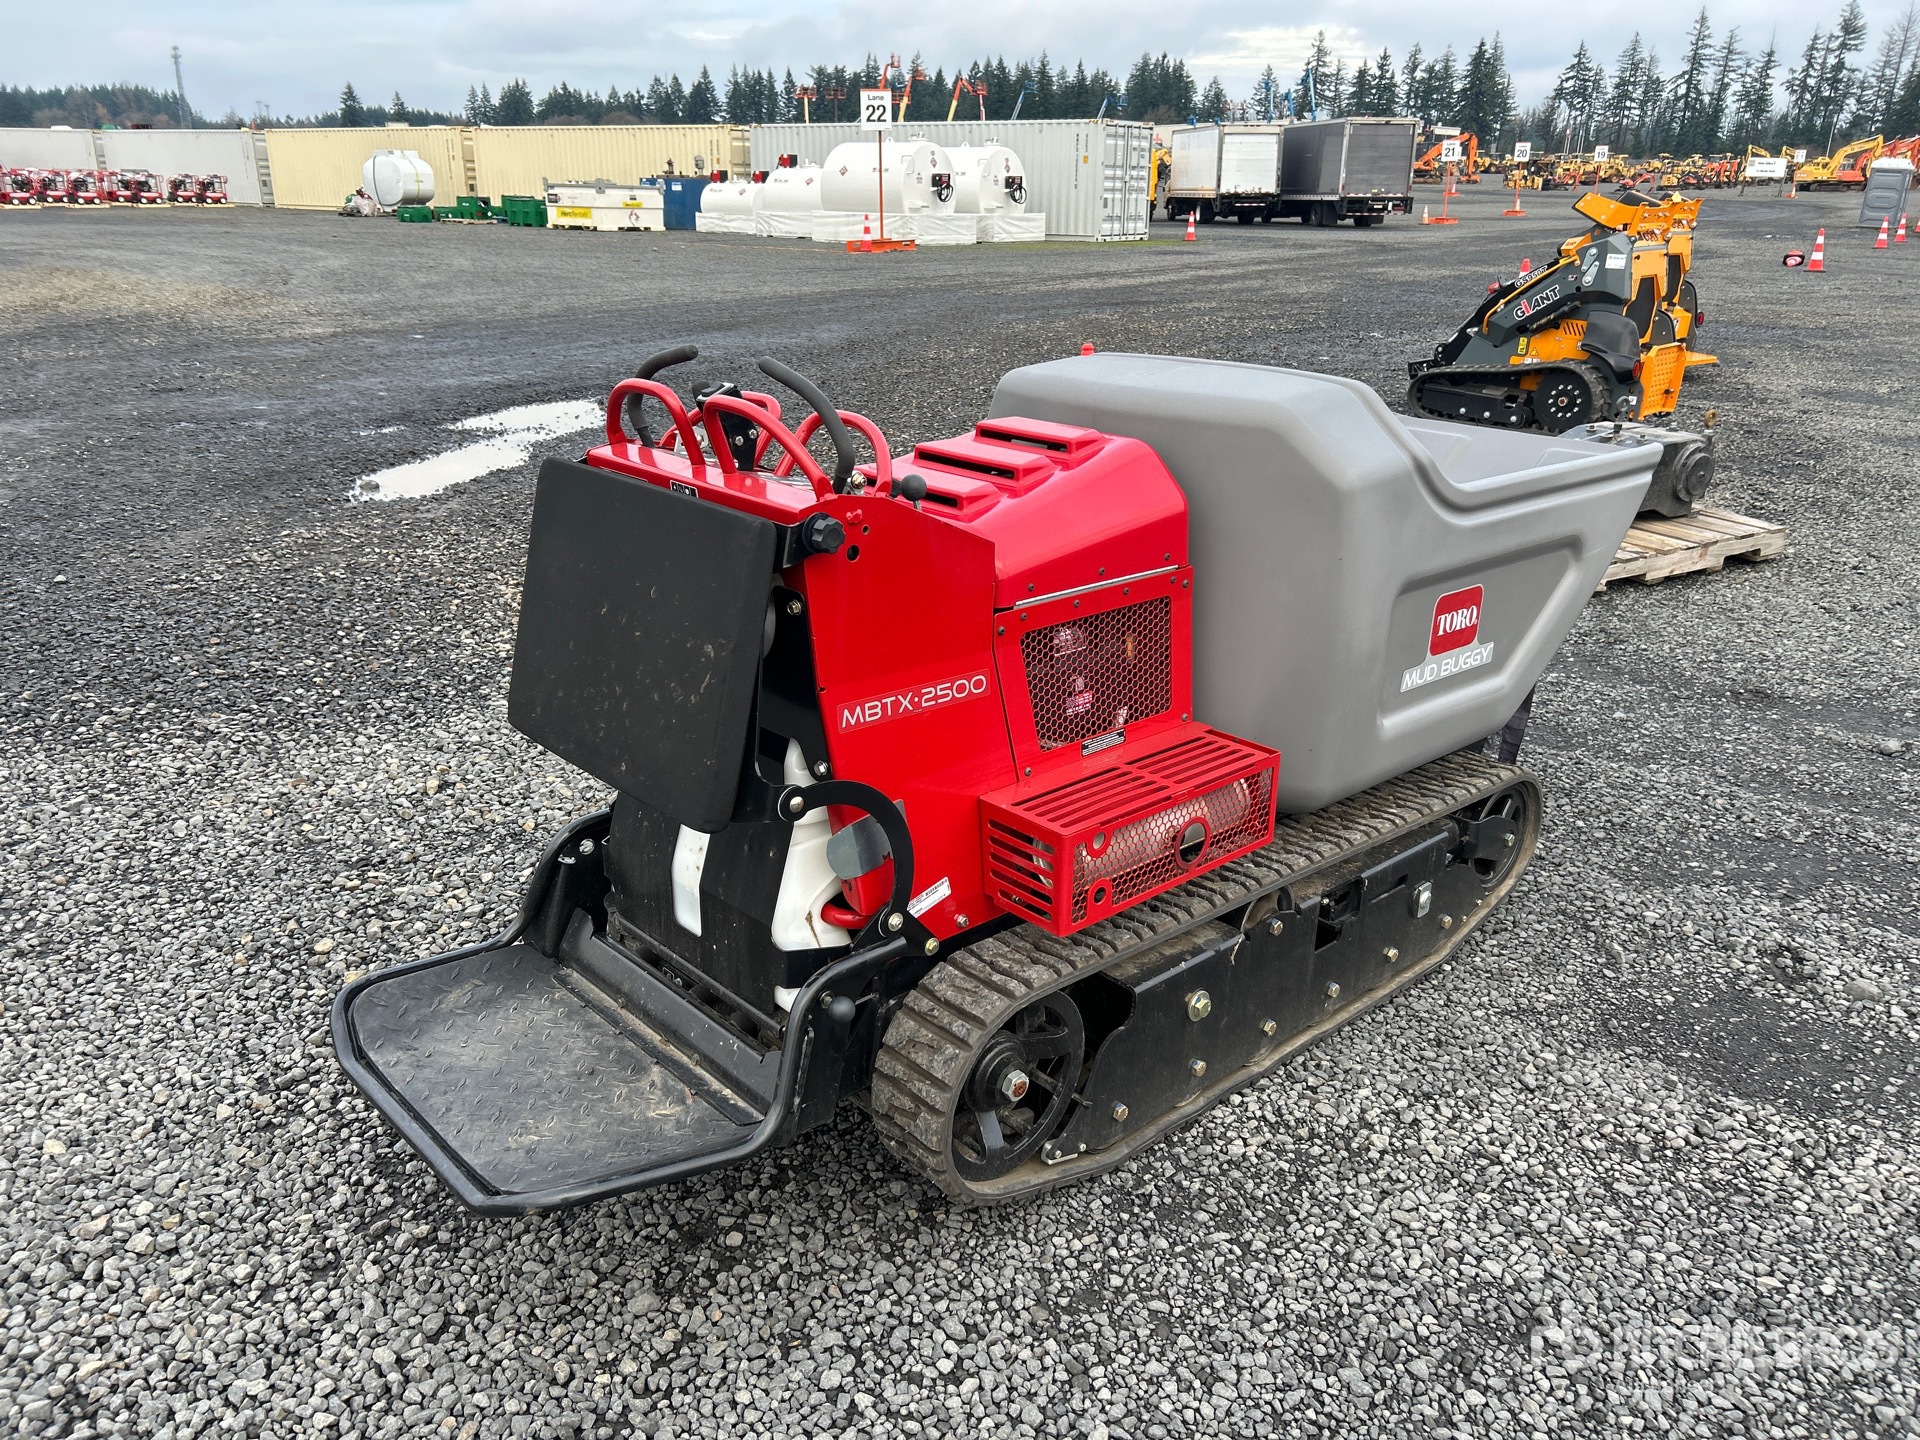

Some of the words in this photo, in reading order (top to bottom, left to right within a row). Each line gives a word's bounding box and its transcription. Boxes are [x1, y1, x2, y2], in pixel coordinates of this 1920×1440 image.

[865, 104, 887, 123] 22
[1444, 147, 1456, 157] 21
[1516, 149, 1528, 158] 20
[1597, 151, 1606, 159] 19
[1437, 605, 1477, 637] TORO
[1402, 664, 1438, 689] MUD
[1440, 644, 1493, 675] BUGGY
